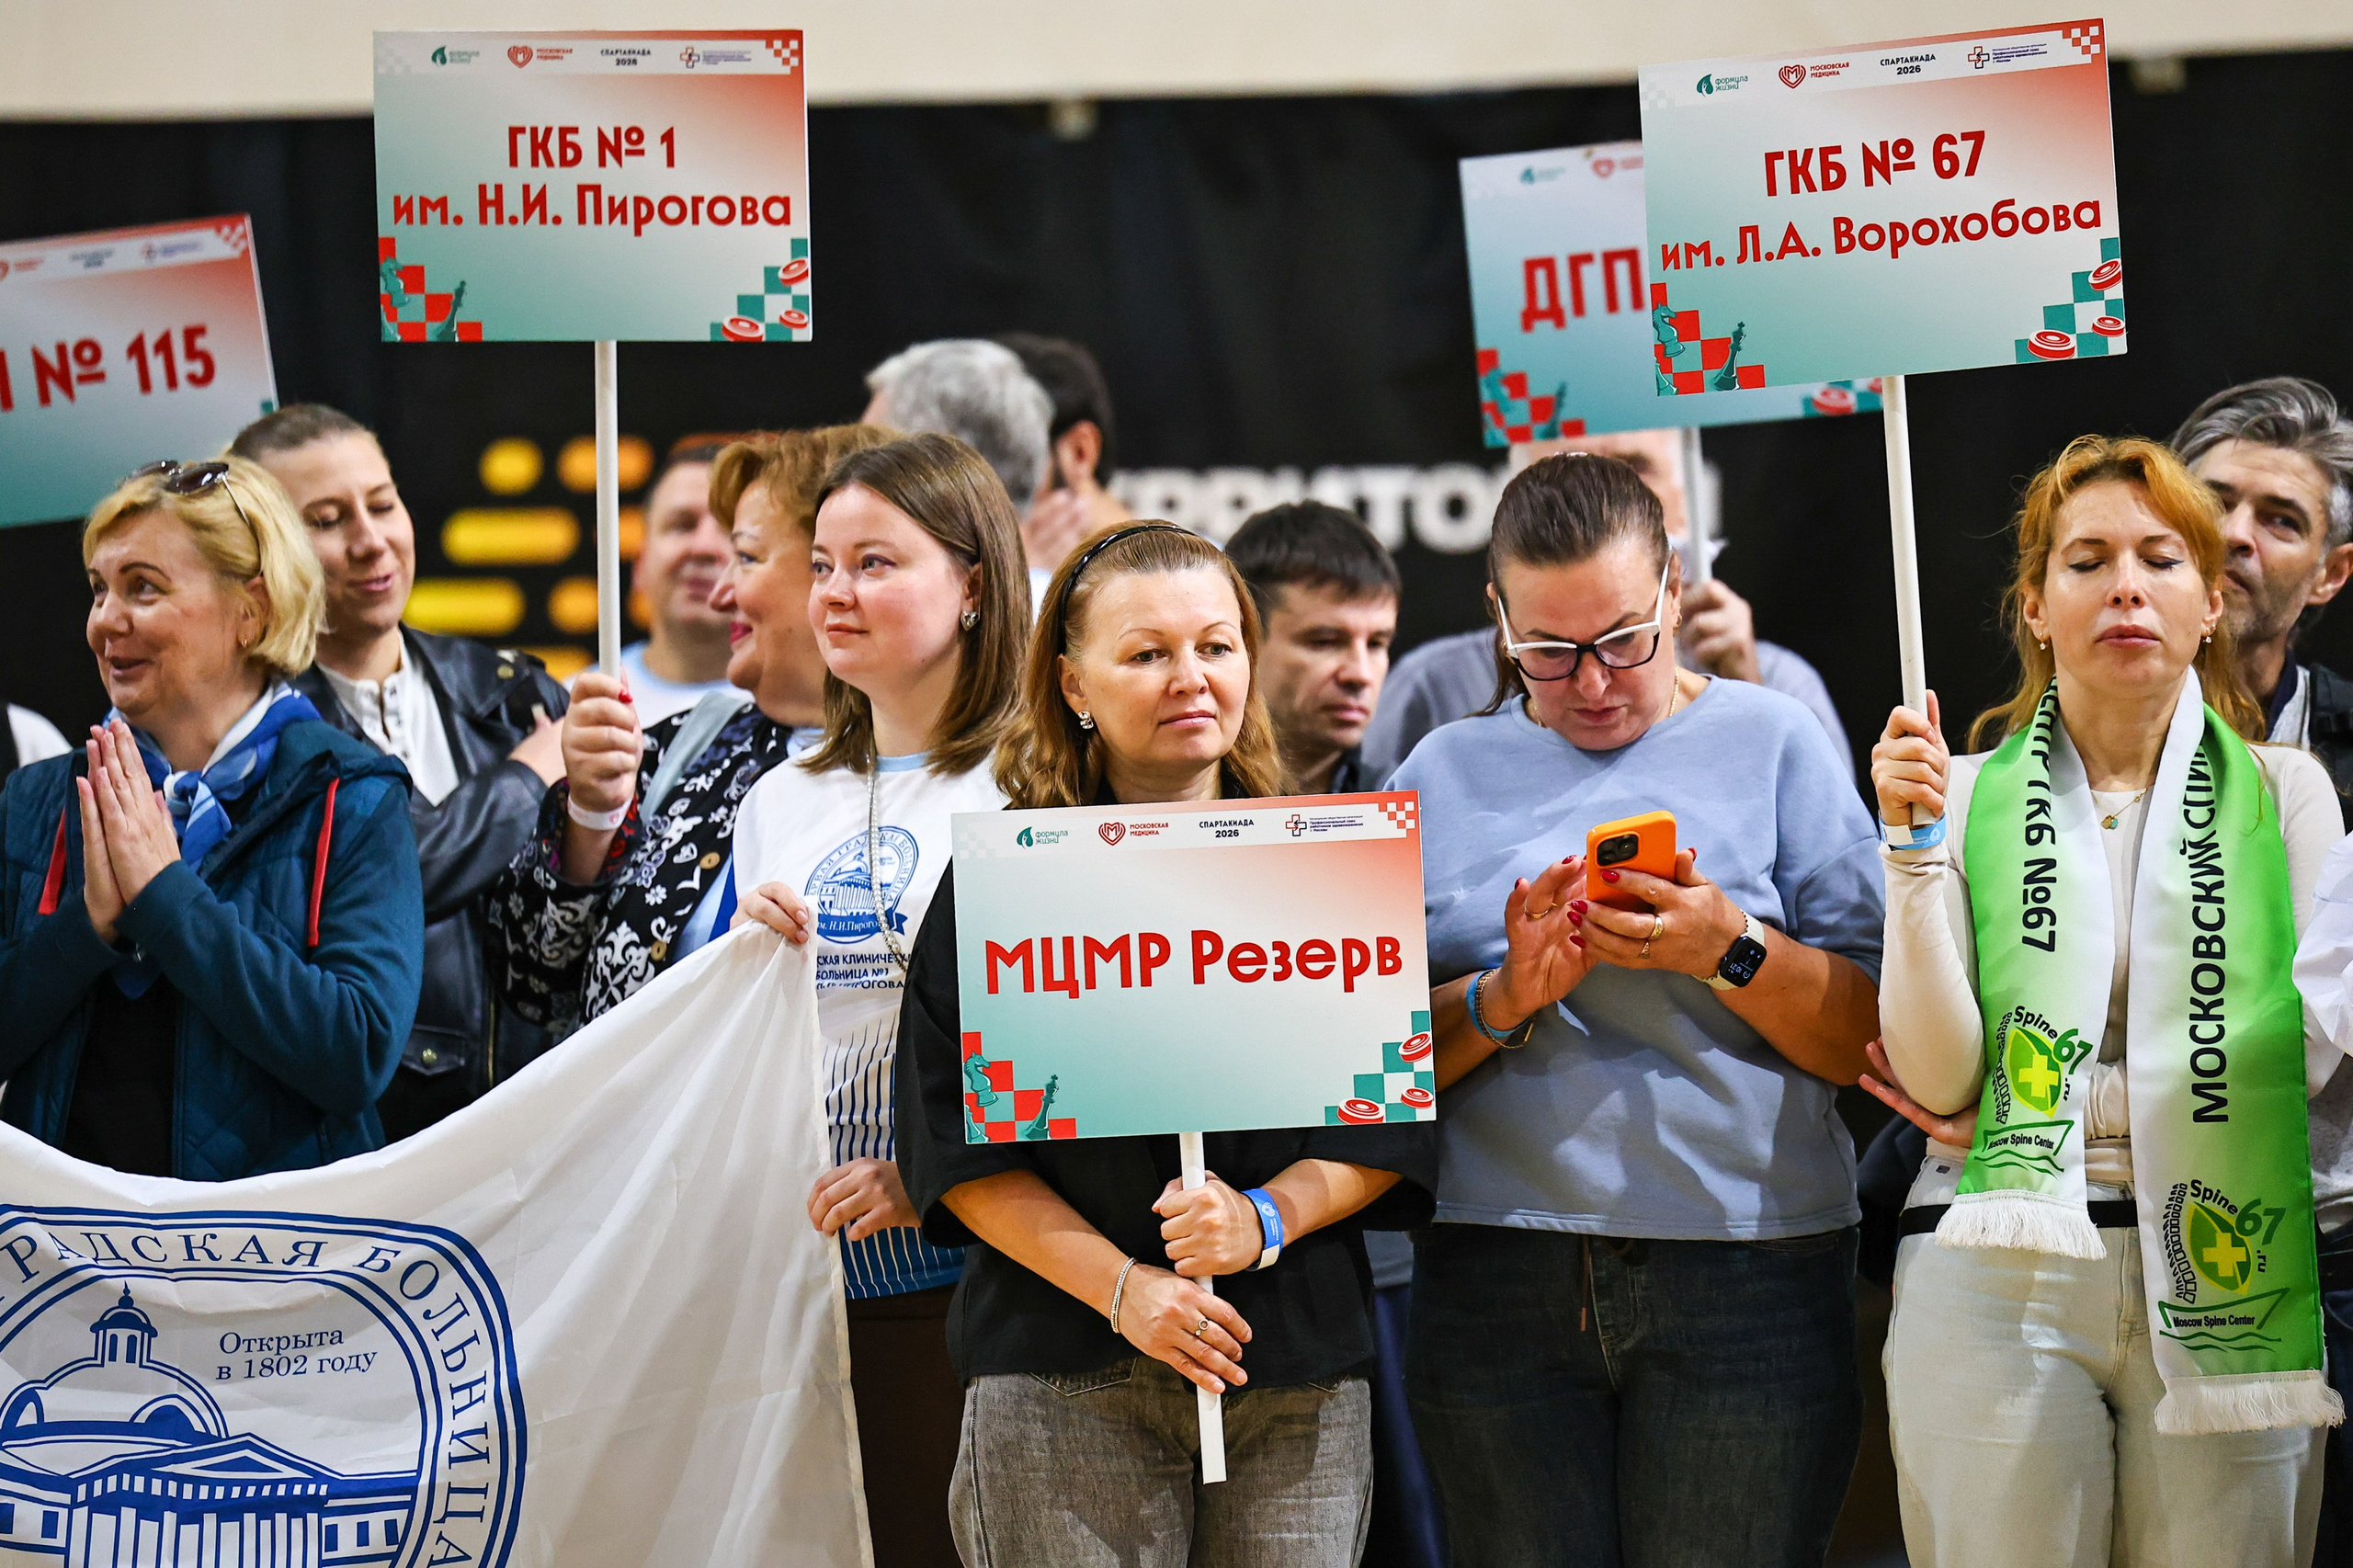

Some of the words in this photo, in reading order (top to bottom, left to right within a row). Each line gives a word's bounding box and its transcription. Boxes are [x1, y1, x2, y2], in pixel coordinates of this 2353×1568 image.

[1810, 62, 1850, 72] МОСКОВСКАЯ
[1810, 70, 1841, 79] МЕДИЦИНА
[1880, 53, 1936, 67] СПАРТАКИАДА
[1896, 64, 1922, 75] 2026
[507, 125, 583, 169] ГКБ
[597, 125, 645, 169] №
[660, 125, 676, 169] 1
[1764, 144, 1847, 198] ГКБ
[1861, 137, 1915, 187] №
[1932, 130, 1985, 180] 67
[392, 194, 464, 226] им.
[478, 184, 563, 226] Н.И.
[576, 184, 791, 238] Пирогова
[1661, 240, 1725, 271] им.
[1737, 221, 1822, 264] Л.А.
[1833, 198, 2102, 259] Ворохобова
[1520, 247, 1645, 334] ДГП
[30, 336, 107, 408] №
[126, 323, 216, 395] 115
[1129, 822, 1169, 830] МОСКОВСКАЯ
[1199, 818, 1255, 829] СПАРТАКИАДА
[1214, 829, 1240, 838] 2026
[816, 955, 840, 967] СКАЯ
[984, 932, 1172, 999] МЦМР
[1191, 929, 1403, 994] Резерв
[2179, 829, 2229, 1123] МОСКОВСКИЙ
[2013, 1006, 2059, 1040] Spine
[2053, 1028, 2094, 1075] 67
[2009, 1132, 2033, 1147] Spine
[2034, 1132, 2055, 1150] Center
[2189, 1178, 2239, 1216] Spine
[2234, 1198, 2287, 1246] 67
[2172, 1315, 2203, 1328] Moscow
[2203, 1315, 2227, 1330] Spine
[2228, 1313, 2256, 1326] Center
[219, 1329, 345, 1357] Открыта
[215, 1365, 232, 1381] в
[243, 1354, 308, 1380] 1802
[316, 1351, 379, 1374] году
[0, 1232, 329, 1287] РАДСКАЯ
[352, 1245, 491, 1568] БОЛЬНИЦА
